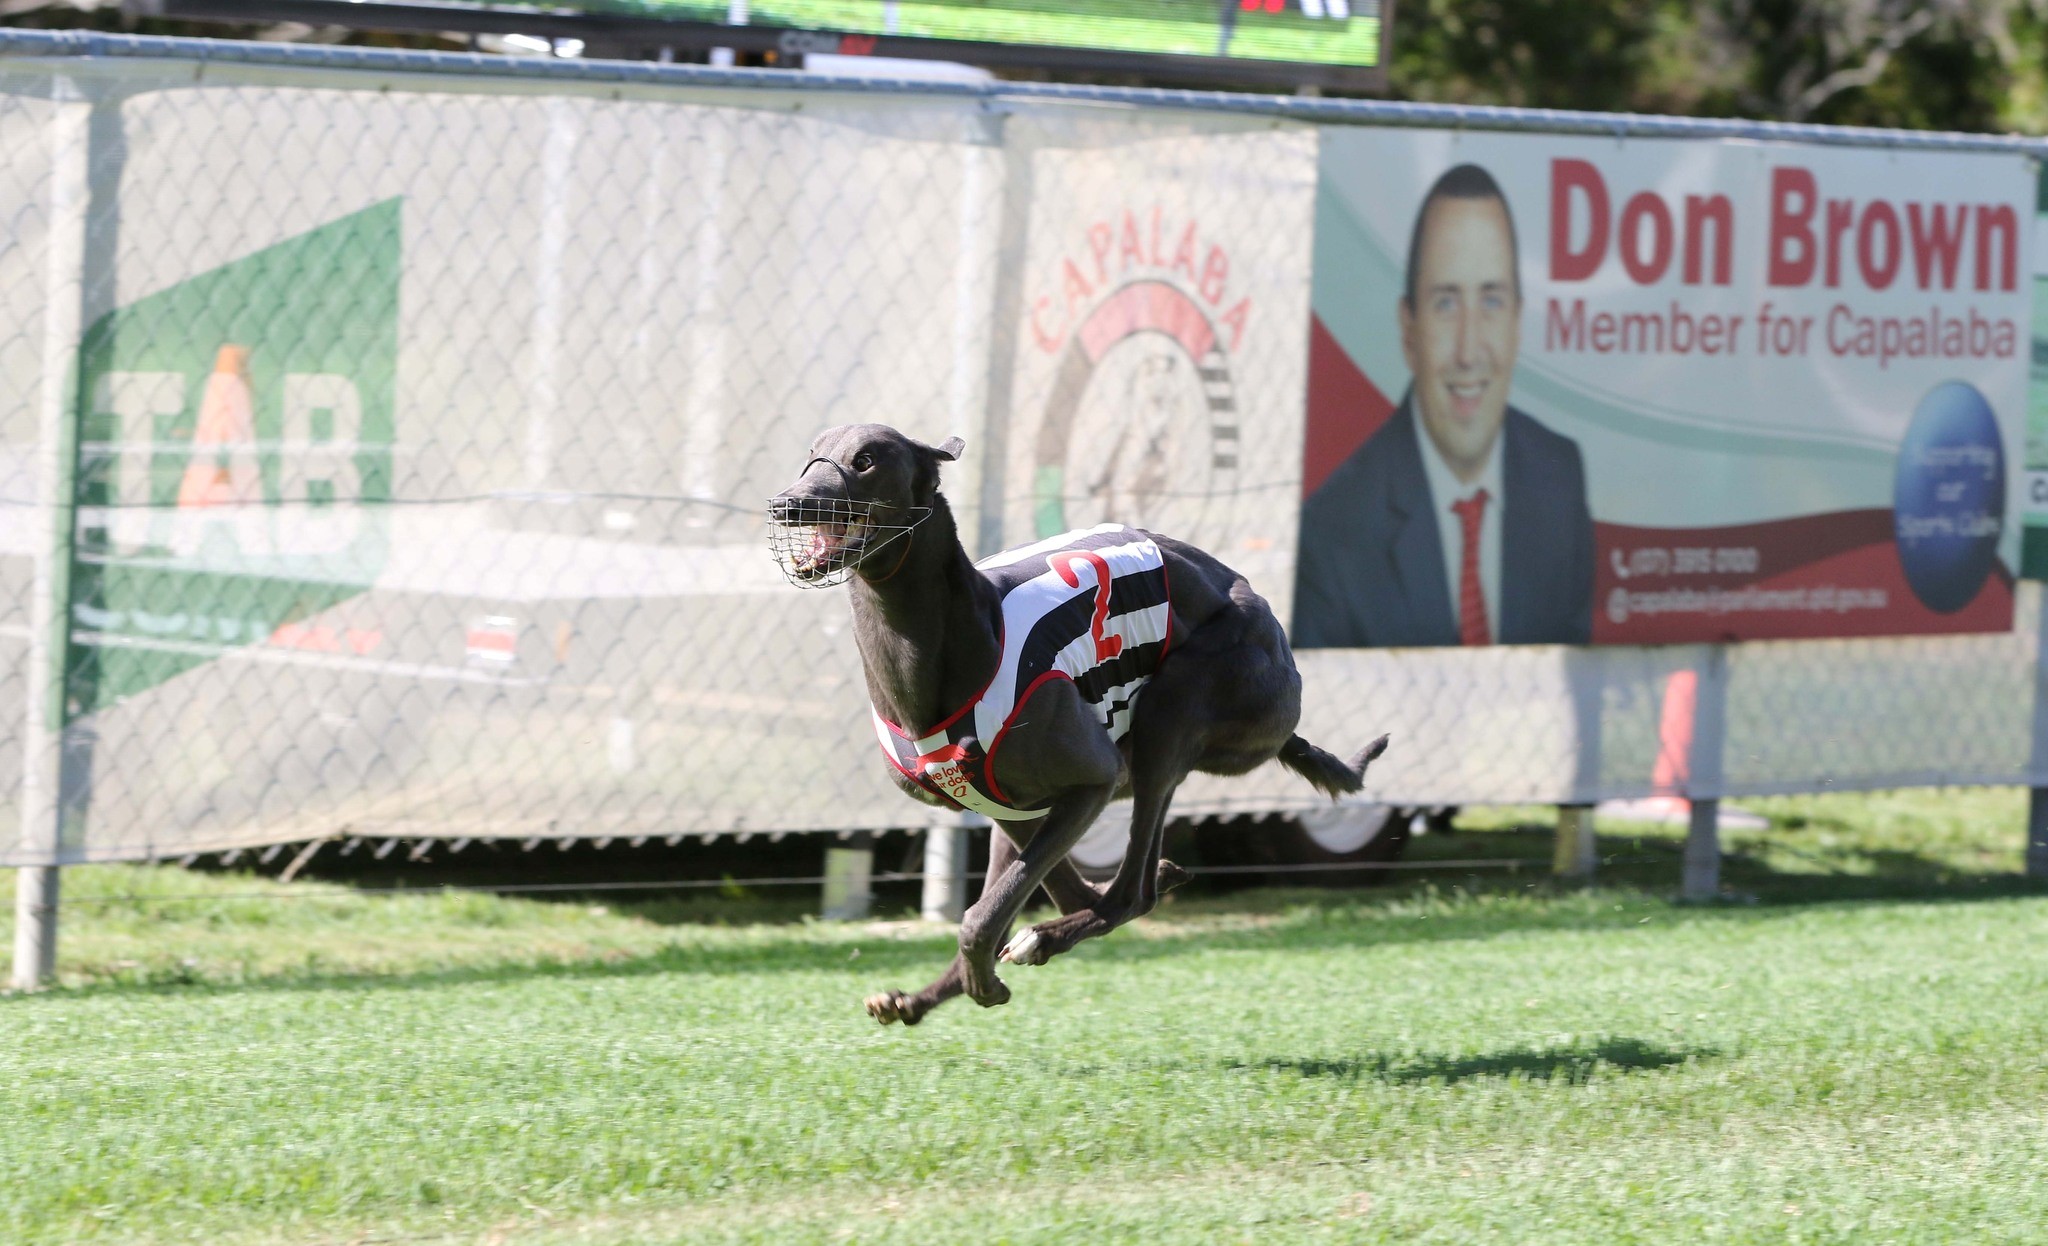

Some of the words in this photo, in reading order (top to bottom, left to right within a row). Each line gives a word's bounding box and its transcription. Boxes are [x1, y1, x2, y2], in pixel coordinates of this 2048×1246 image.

[1031, 206, 1252, 352] CAPALABA
[1548, 158, 1733, 286] Don
[1767, 166, 2018, 292] Brown
[1545, 298, 1743, 355] Member
[1757, 303, 1812, 355] for
[1827, 304, 2016, 370] Capalaba
[94, 371, 361, 555] TAB
[1048, 551, 1122, 665] 2
[942, 764, 965, 777] love
[948, 771, 975, 787] dogs
